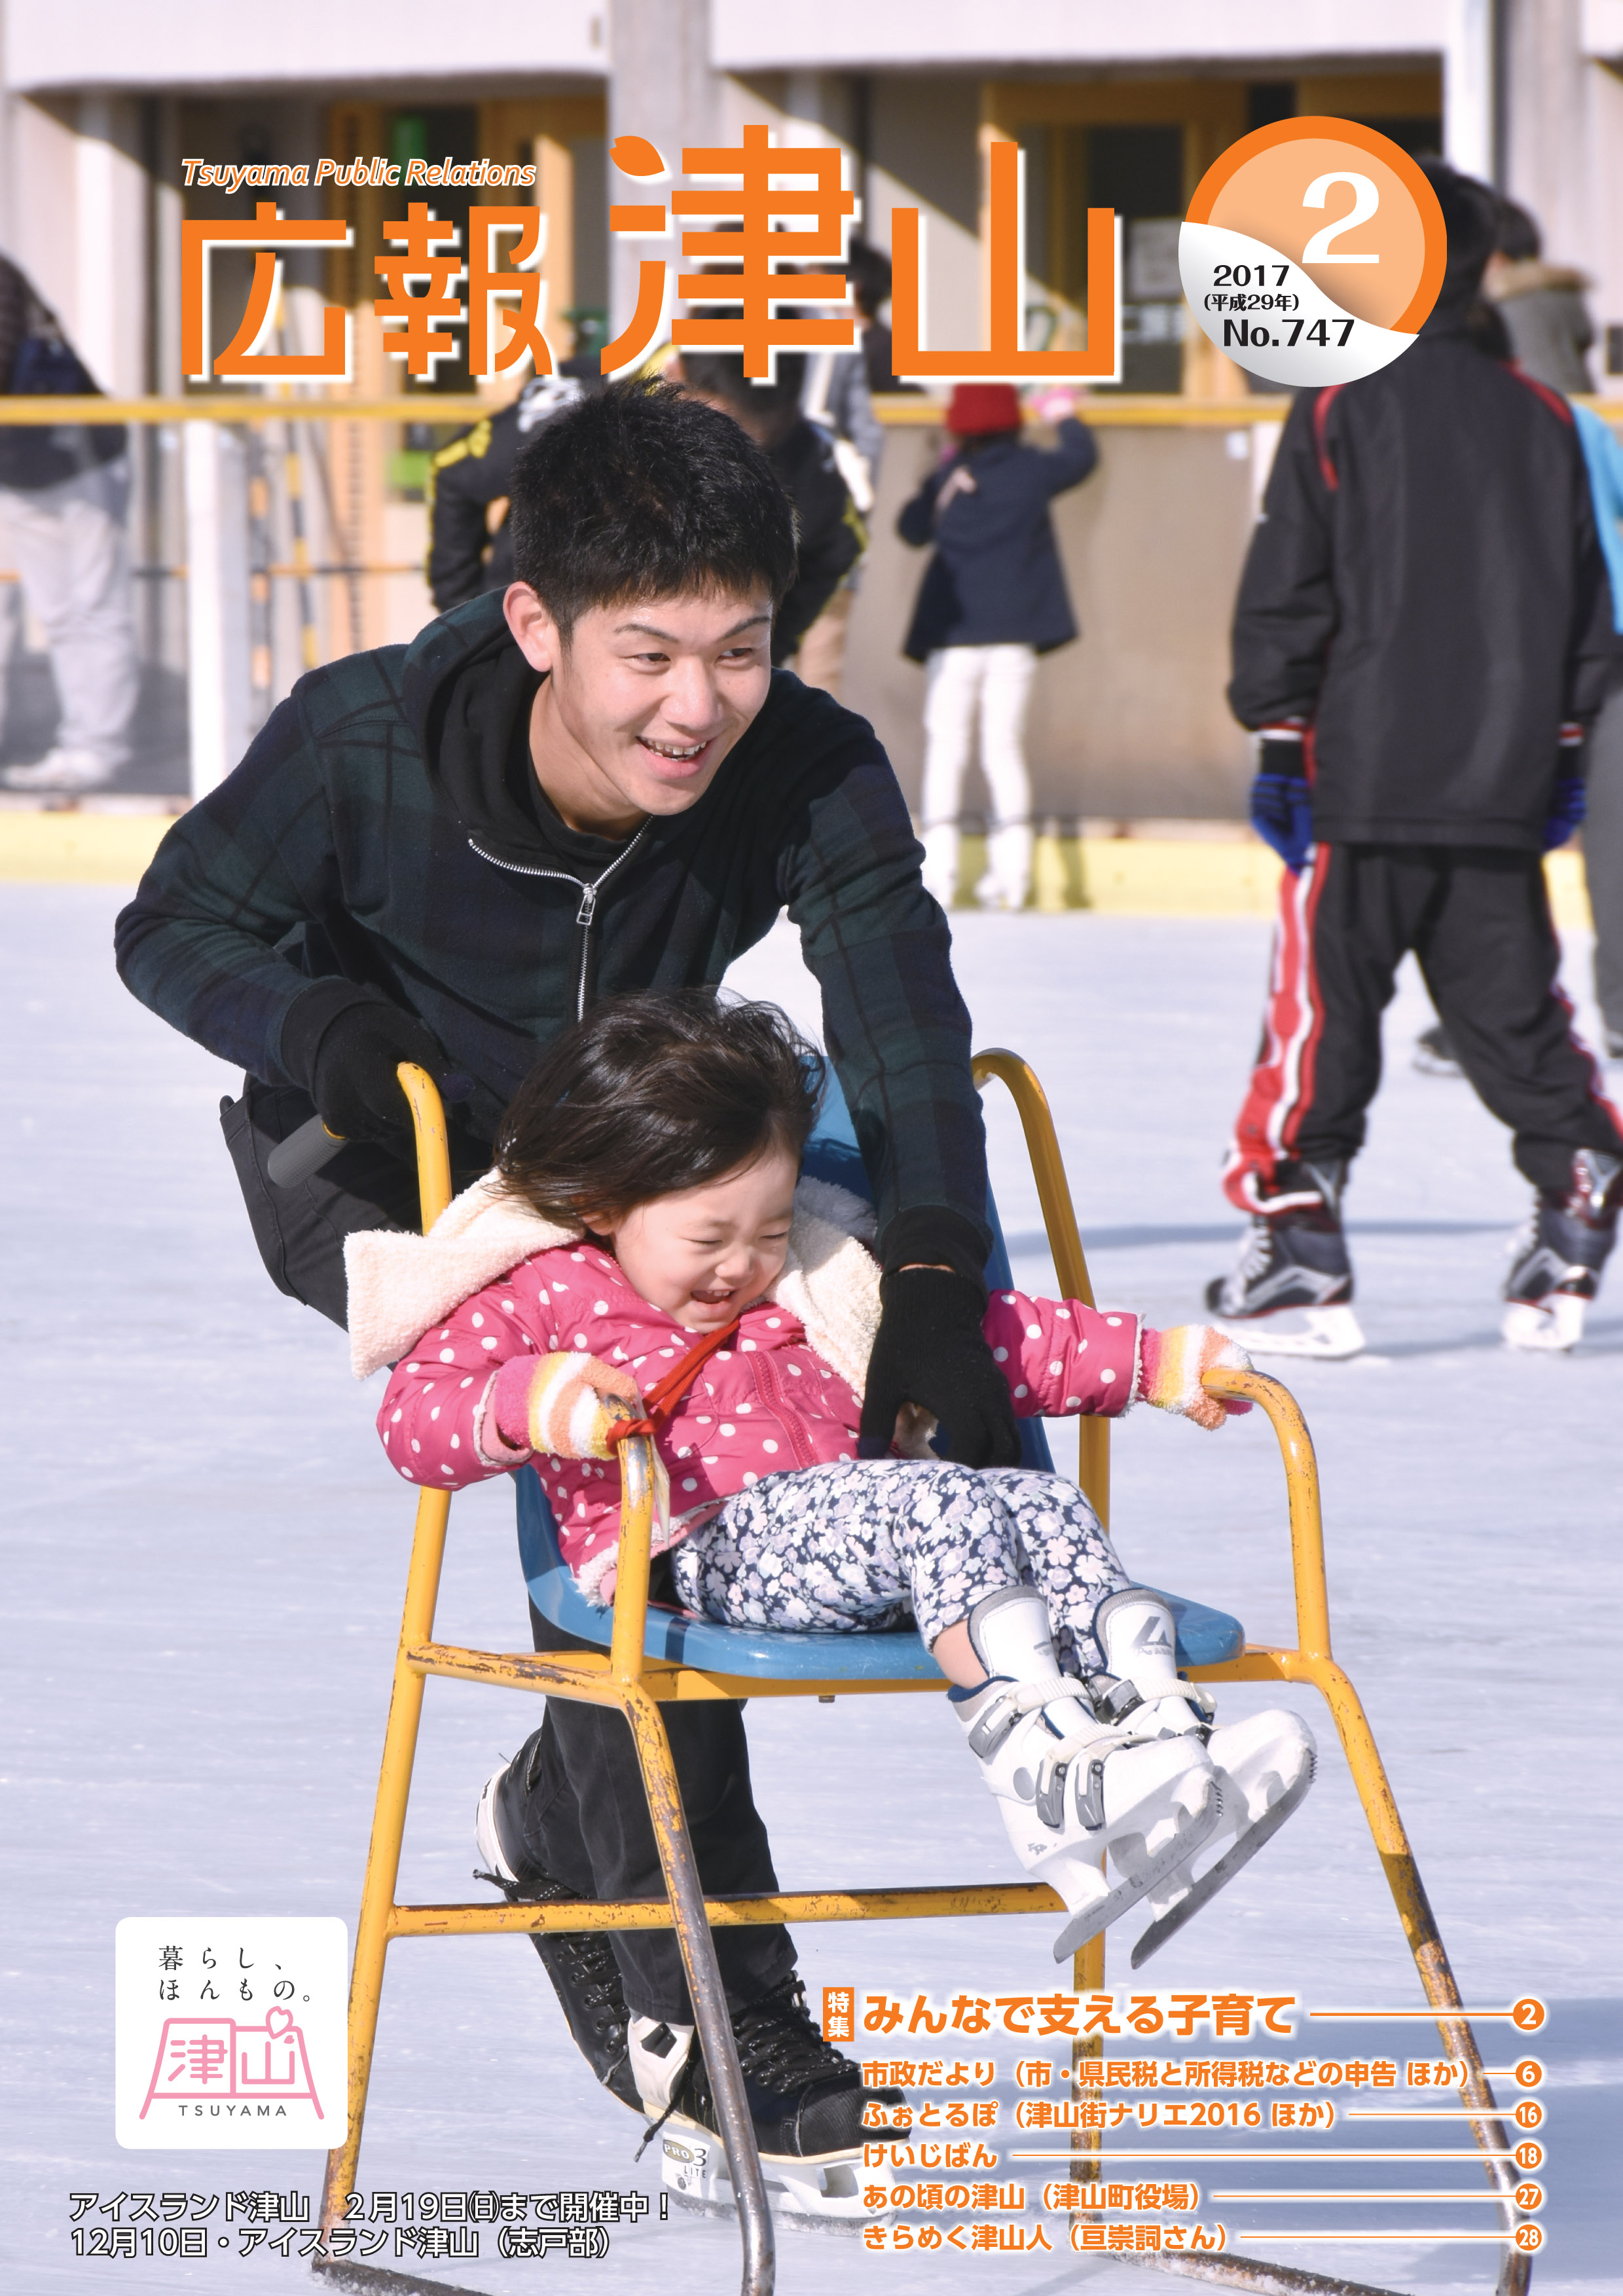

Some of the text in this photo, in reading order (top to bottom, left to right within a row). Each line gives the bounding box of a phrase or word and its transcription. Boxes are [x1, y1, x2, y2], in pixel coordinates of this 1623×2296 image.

[664, 2144, 706, 2166] PRO 3
[684, 2166, 706, 2178] LITE
